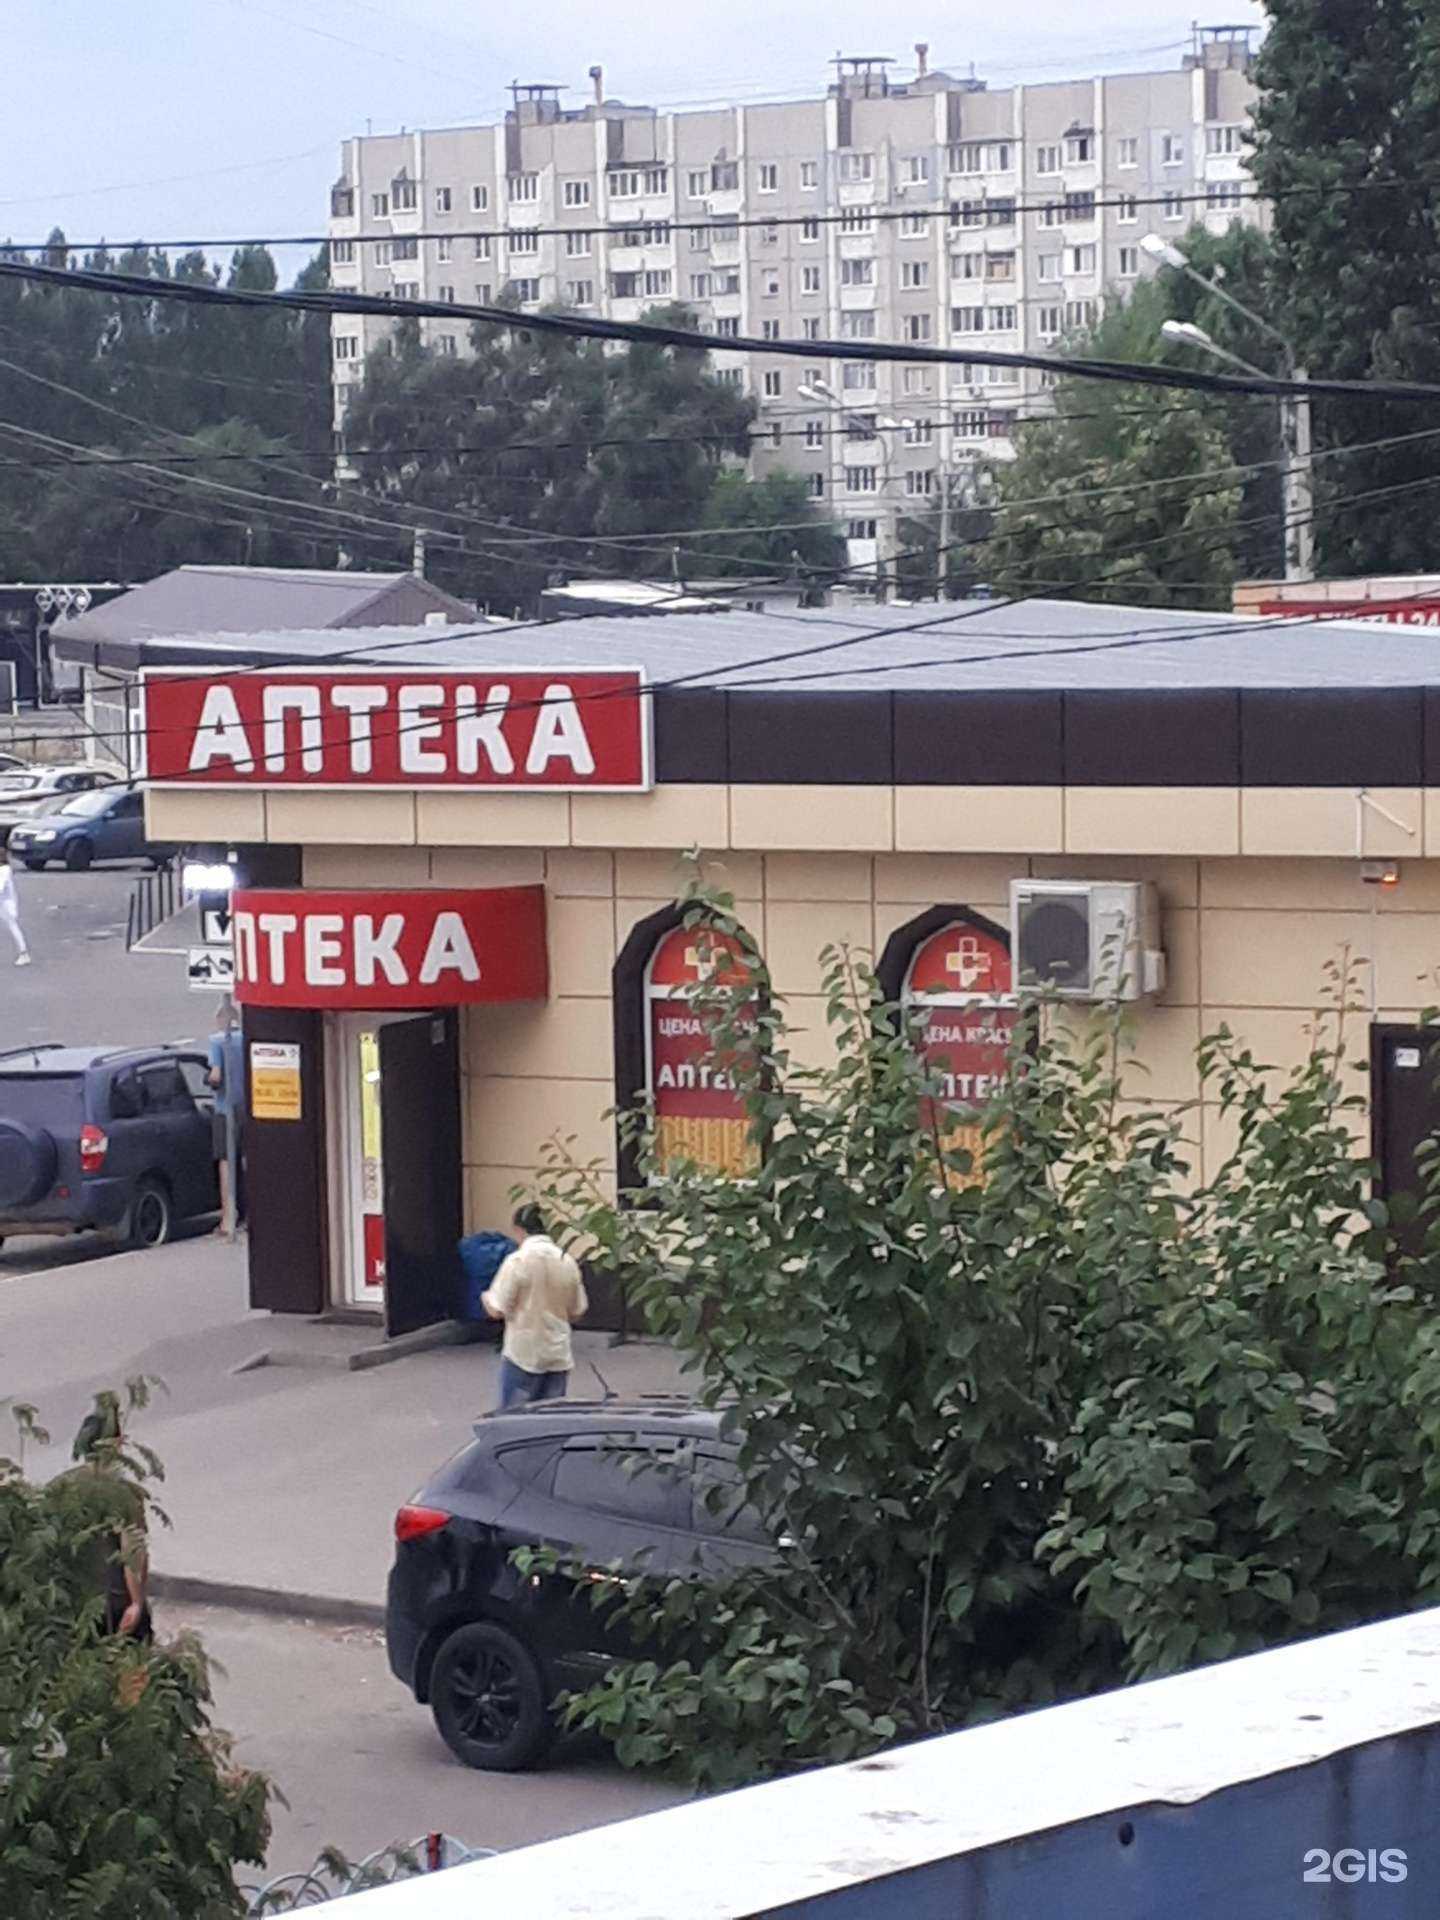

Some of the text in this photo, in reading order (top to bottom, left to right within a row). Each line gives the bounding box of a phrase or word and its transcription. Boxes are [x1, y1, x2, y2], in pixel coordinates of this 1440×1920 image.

[188, 684, 596, 775] АПТЕКА
[235, 911, 481, 986] ПТЕКА
[658, 1018, 702, 1038] ЦЕНА
[657, 1063, 740, 1090] АПТЕ
